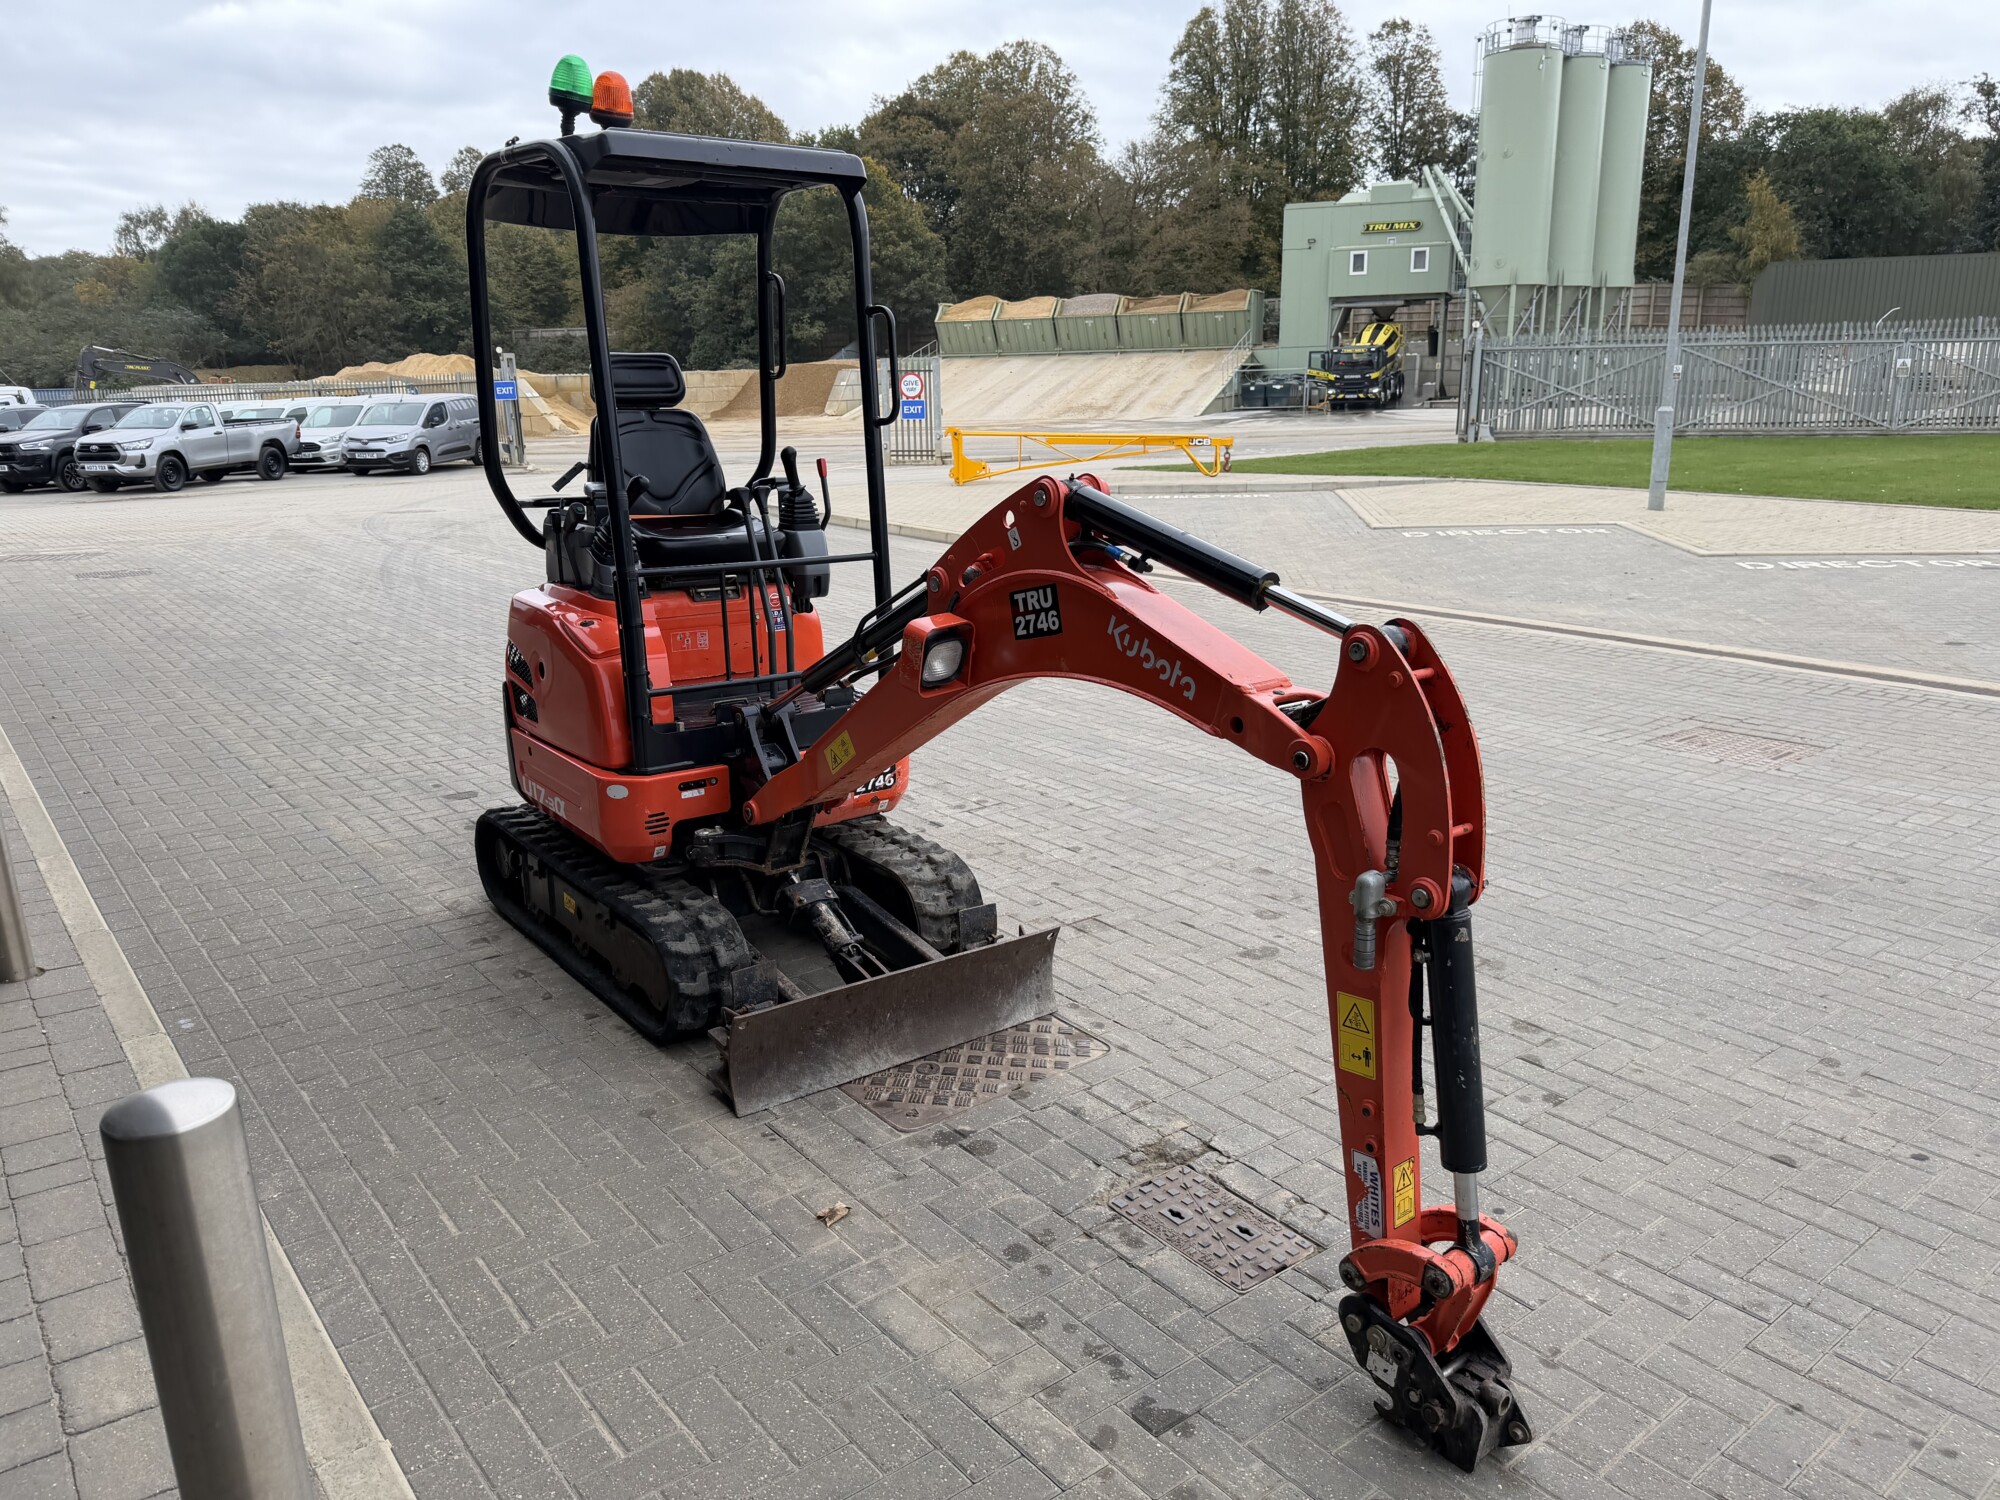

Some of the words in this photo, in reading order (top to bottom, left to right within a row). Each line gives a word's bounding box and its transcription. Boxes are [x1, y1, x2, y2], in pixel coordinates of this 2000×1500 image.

[1368, 223, 1391, 231] TRU
[1393, 221, 1417, 229] MIX
[496, 386, 513, 394] EXIT
[903, 405, 922, 413] EXIT
[1189, 438, 1211, 446] JCB
[1401, 527, 1612, 538] DIRECTOR
[1735, 559, 2000, 570] DIRECTOR
[1013, 587, 1053, 613] TRU
[1015, 610, 1060, 636] 2746
[1107, 614, 1197, 701] Kubota
[1369, 1171, 1380, 1228] WHITES
